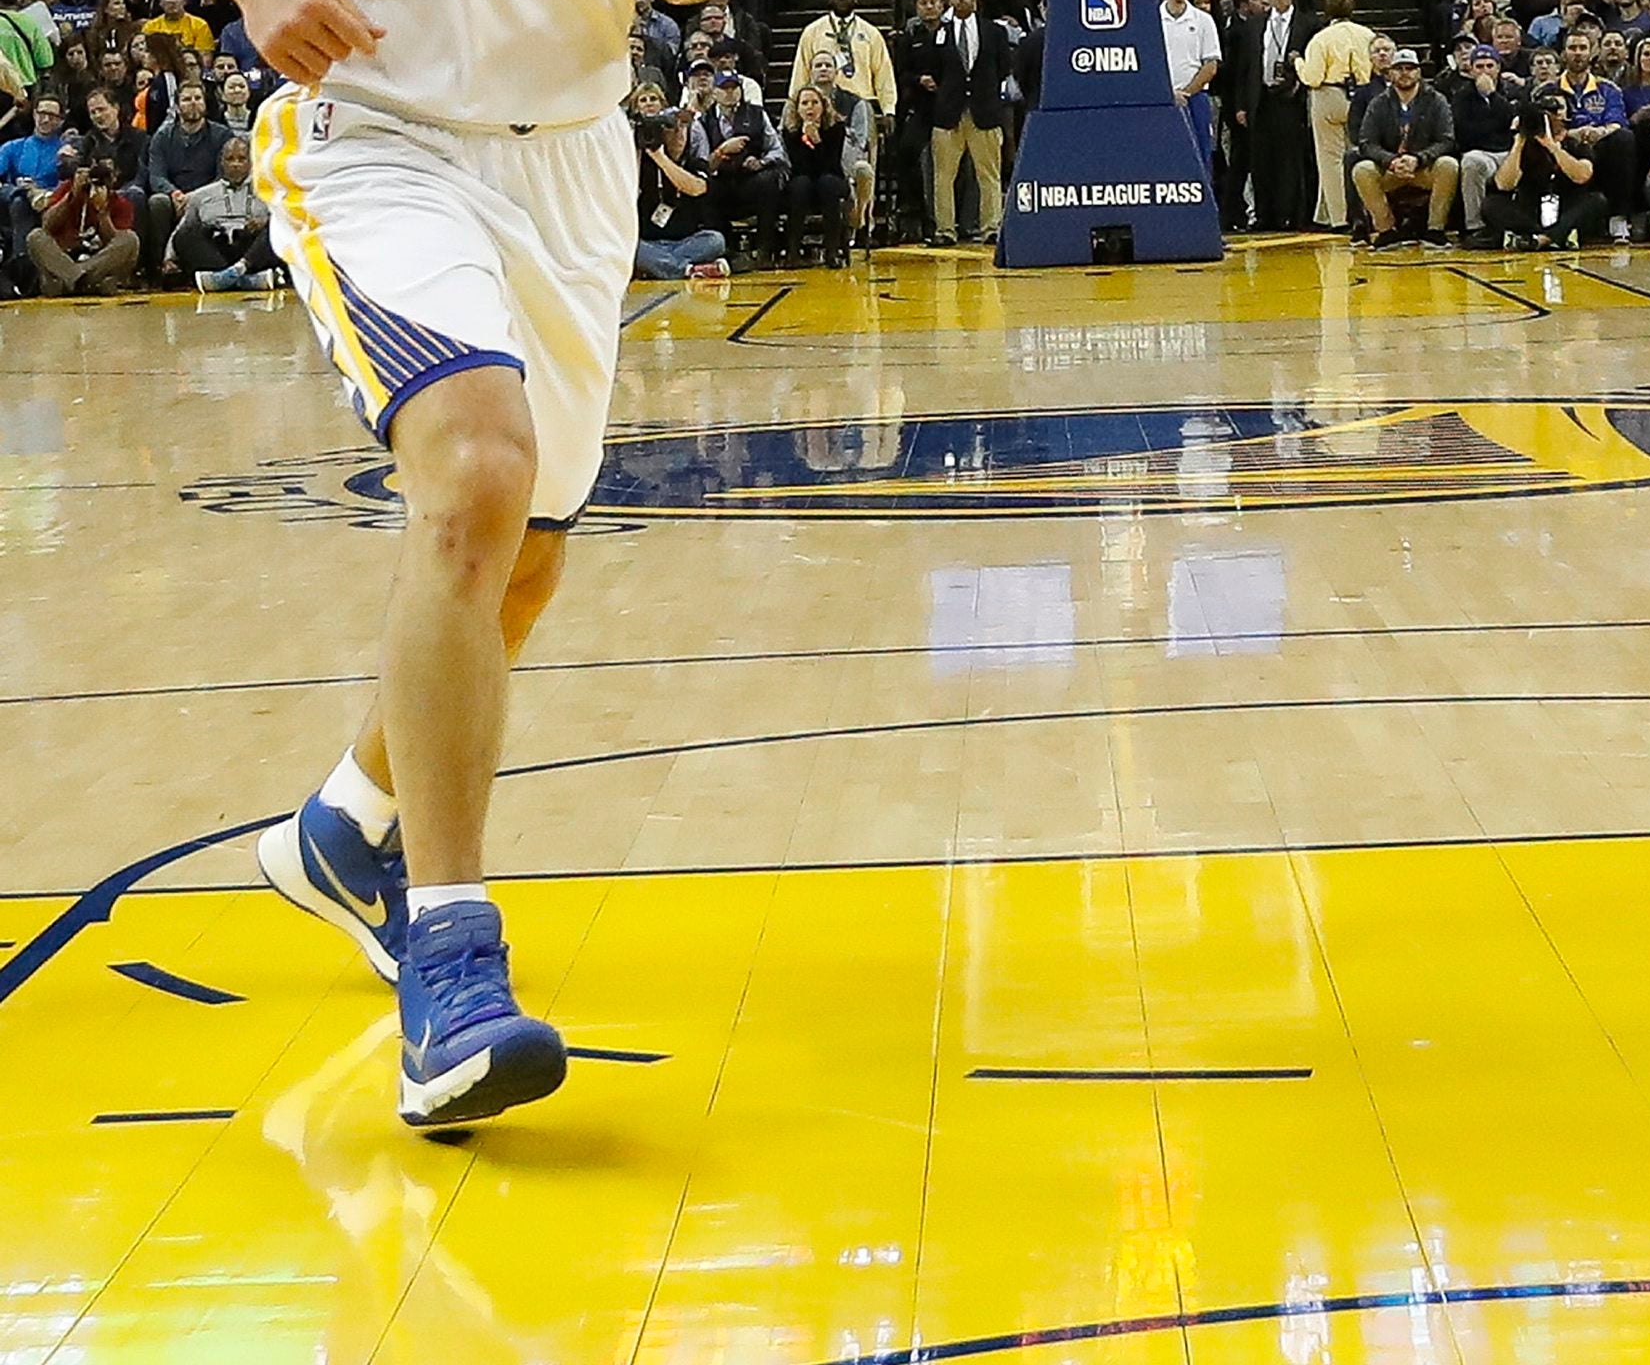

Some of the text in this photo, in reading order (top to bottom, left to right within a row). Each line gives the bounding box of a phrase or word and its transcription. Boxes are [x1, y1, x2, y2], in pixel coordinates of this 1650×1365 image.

[1072, 47, 1138, 72] @NBA
[1040, 182, 1202, 207] NBA LEAGUE PASS
